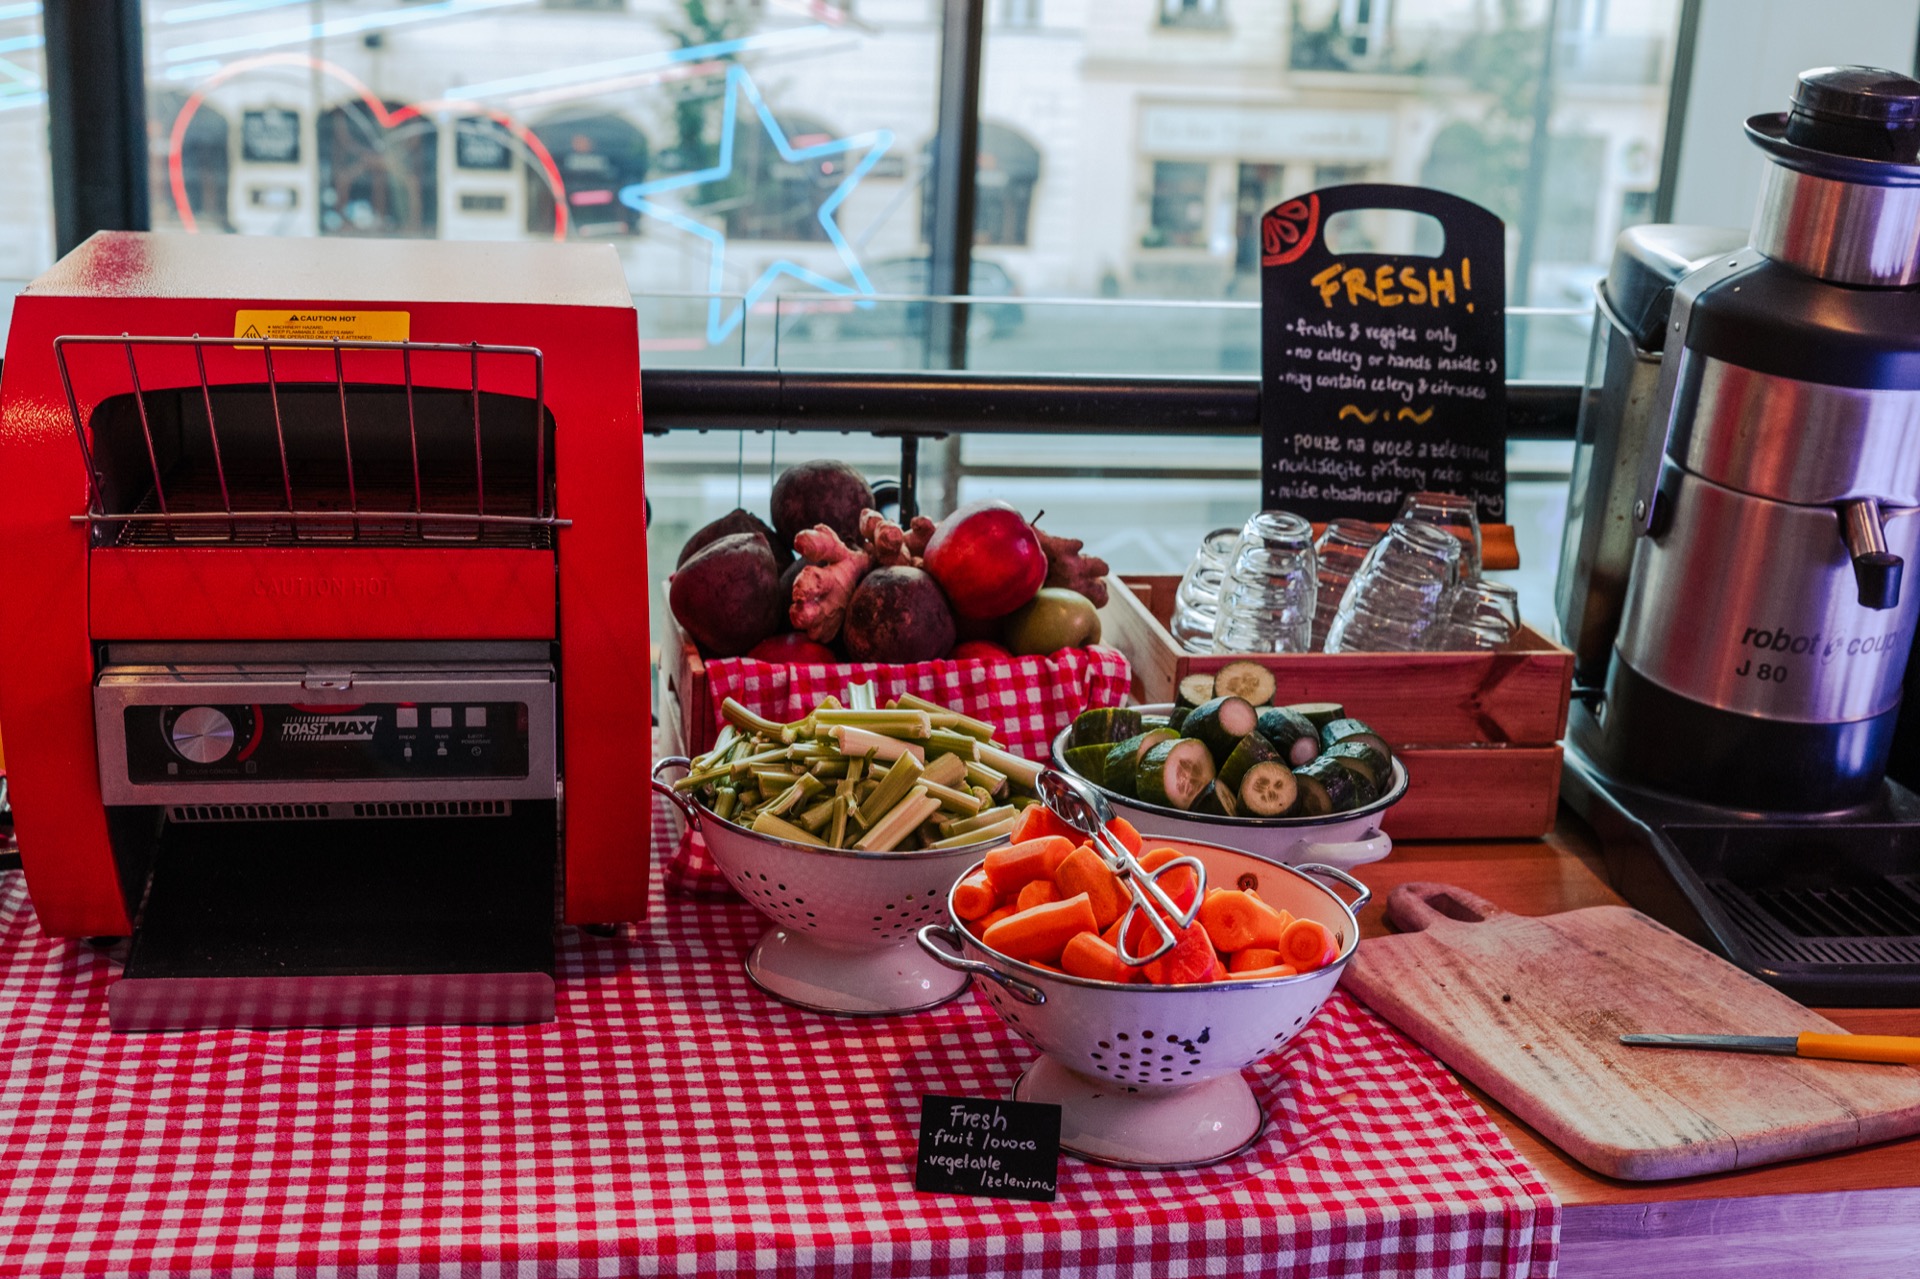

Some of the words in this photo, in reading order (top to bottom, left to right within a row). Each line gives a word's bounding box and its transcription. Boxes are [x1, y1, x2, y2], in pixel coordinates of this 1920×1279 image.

[1311, 257, 1474, 313] FRESH!
[1296, 318, 1345, 339] fruits
[1365, 324, 1417, 350] veggies
[1425, 326, 1457, 352] only
[1295, 348, 1311, 360] no
[1317, 347, 1362, 371] cutlery
[1368, 354, 1383, 367] or
[1387, 354, 1432, 371] hands
[1438, 354, 1480, 372] inside
[1286, 373, 1312, 392] may
[1316, 374, 1366, 390] contain
[1371, 376, 1414, 401] celery
[1431, 378, 1487, 400] citruses
[1293, 434, 1341, 454] pouze
[1347, 436, 1366, 453] na
[1372, 440, 1414, 457] ovoce
[1321, 483, 1403, 505] obsahovat
[253, 577, 346, 596] CAUTION
[353, 577, 392, 596] HOT
[1741, 627, 1822, 656] robot
[1846, 628, 1910, 657] coup
[1735, 660, 1751, 677] J
[1757, 663, 1788, 683] 80
[281, 721, 376, 736] TOASTMAX
[950, 1105, 1007, 1131] Fresh
[934, 1128, 974, 1146] fruit
[929, 1153, 1001, 1175] vegetable
